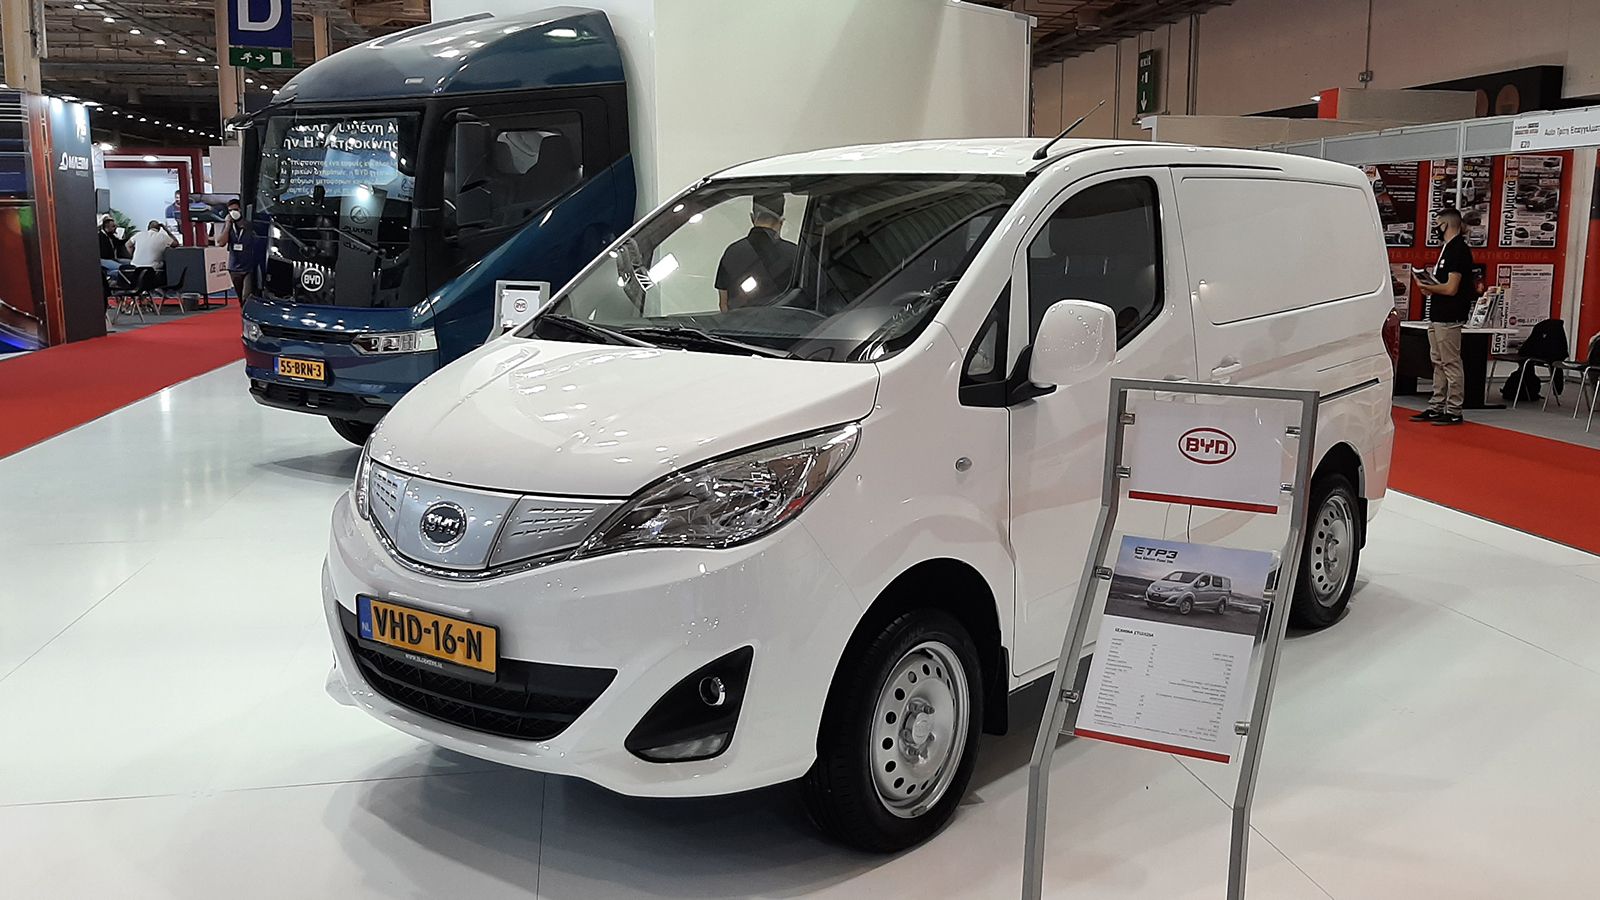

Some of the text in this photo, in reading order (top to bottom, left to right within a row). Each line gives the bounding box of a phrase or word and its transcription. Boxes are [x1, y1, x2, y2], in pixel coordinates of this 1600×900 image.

[237, 0, 282, 31] D
[303, 274, 321, 285] BYD
[280, 360, 322, 377] 55-BRN-3
[1185, 436, 1228, 455] BYD
[1134, 546, 1178, 559] ETP3
[361, 621, 371, 632] NL
[373, 606, 482, 662] VHD-16-N
